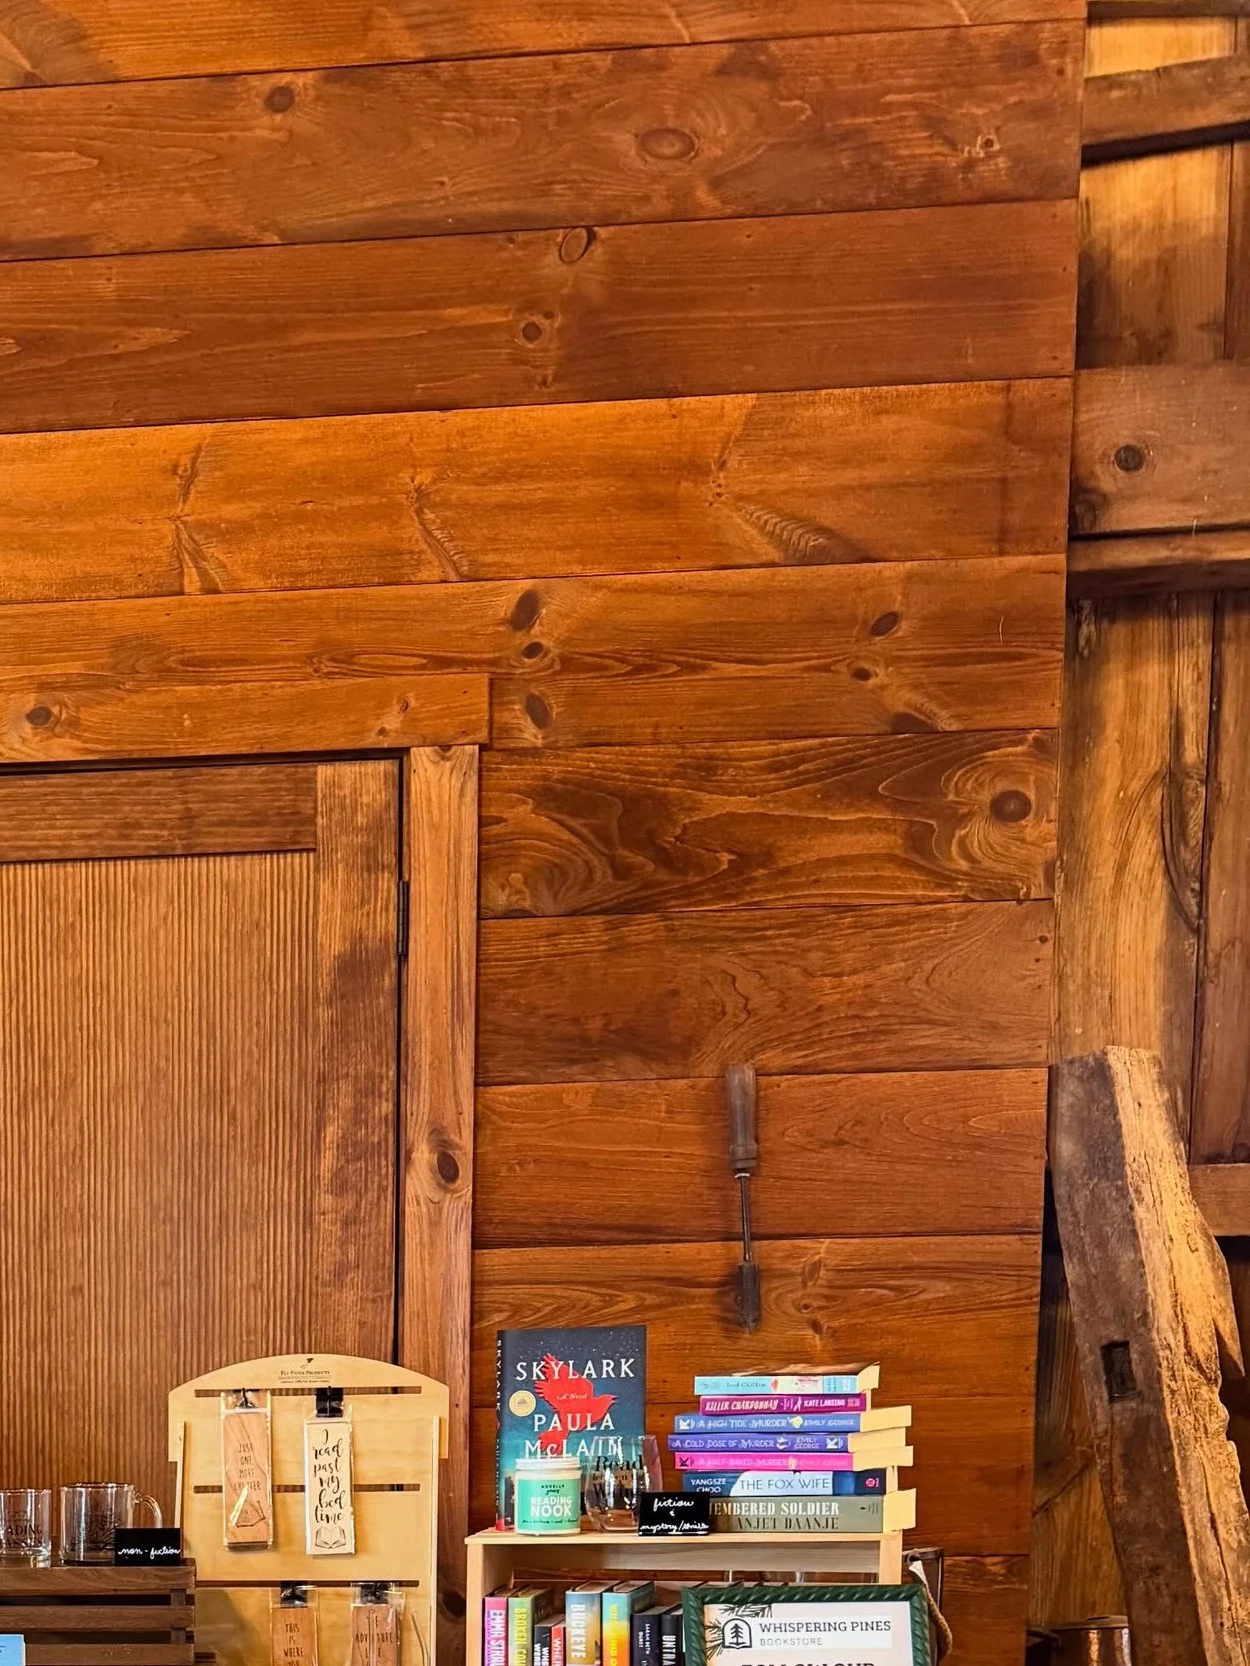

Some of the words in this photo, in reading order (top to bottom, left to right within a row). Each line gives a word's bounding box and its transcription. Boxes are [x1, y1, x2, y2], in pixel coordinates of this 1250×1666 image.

[516, 1358, 636, 1380] SKYLARK
[533, 1413, 616, 1431] PAULA
[730, 1417, 748, 1428] TIDE
[312, 1438, 344, 1458] read
[525, 1437, 624, 1458] McLAIN
[684, 1438, 705, 1448] COLD
[707, 1438, 727, 1448] DOSE
[728, 1438, 738, 1448] OF
[739, 1437, 775, 1449] MURDER
[313, 1462, 340, 1477] past
[319, 1475, 340, 1492] my
[690, 1477, 727, 1485] YANGSZE
[739, 1479, 764, 1491] THE
[767, 1477, 794, 1489] FOX
[798, 1477, 830, 1489] WIFE
[697, 1485, 721, 1493] CHOO
[318, 1490, 346, 1509] bed
[653, 1497, 694, 1512] fiction
[314, 1504, 344, 1524] time
[530, 1505, 572, 1517] NOOK
[709, 1501, 775, 1516] EMBERED
[780, 1501, 840, 1515] SOLDIER
[737, 1516, 779, 1530] ANJET
[784, 1516, 839, 1530] DAANJE
[513, 1608, 527, 1644] BROKEN
[571, 1604, 586, 1658] BUCKEYE
[759, 1622, 848, 1633] WHISPERING
[851, 1620, 891, 1631] PINES
[759, 1637, 822, 1646] BOOKSTORE
